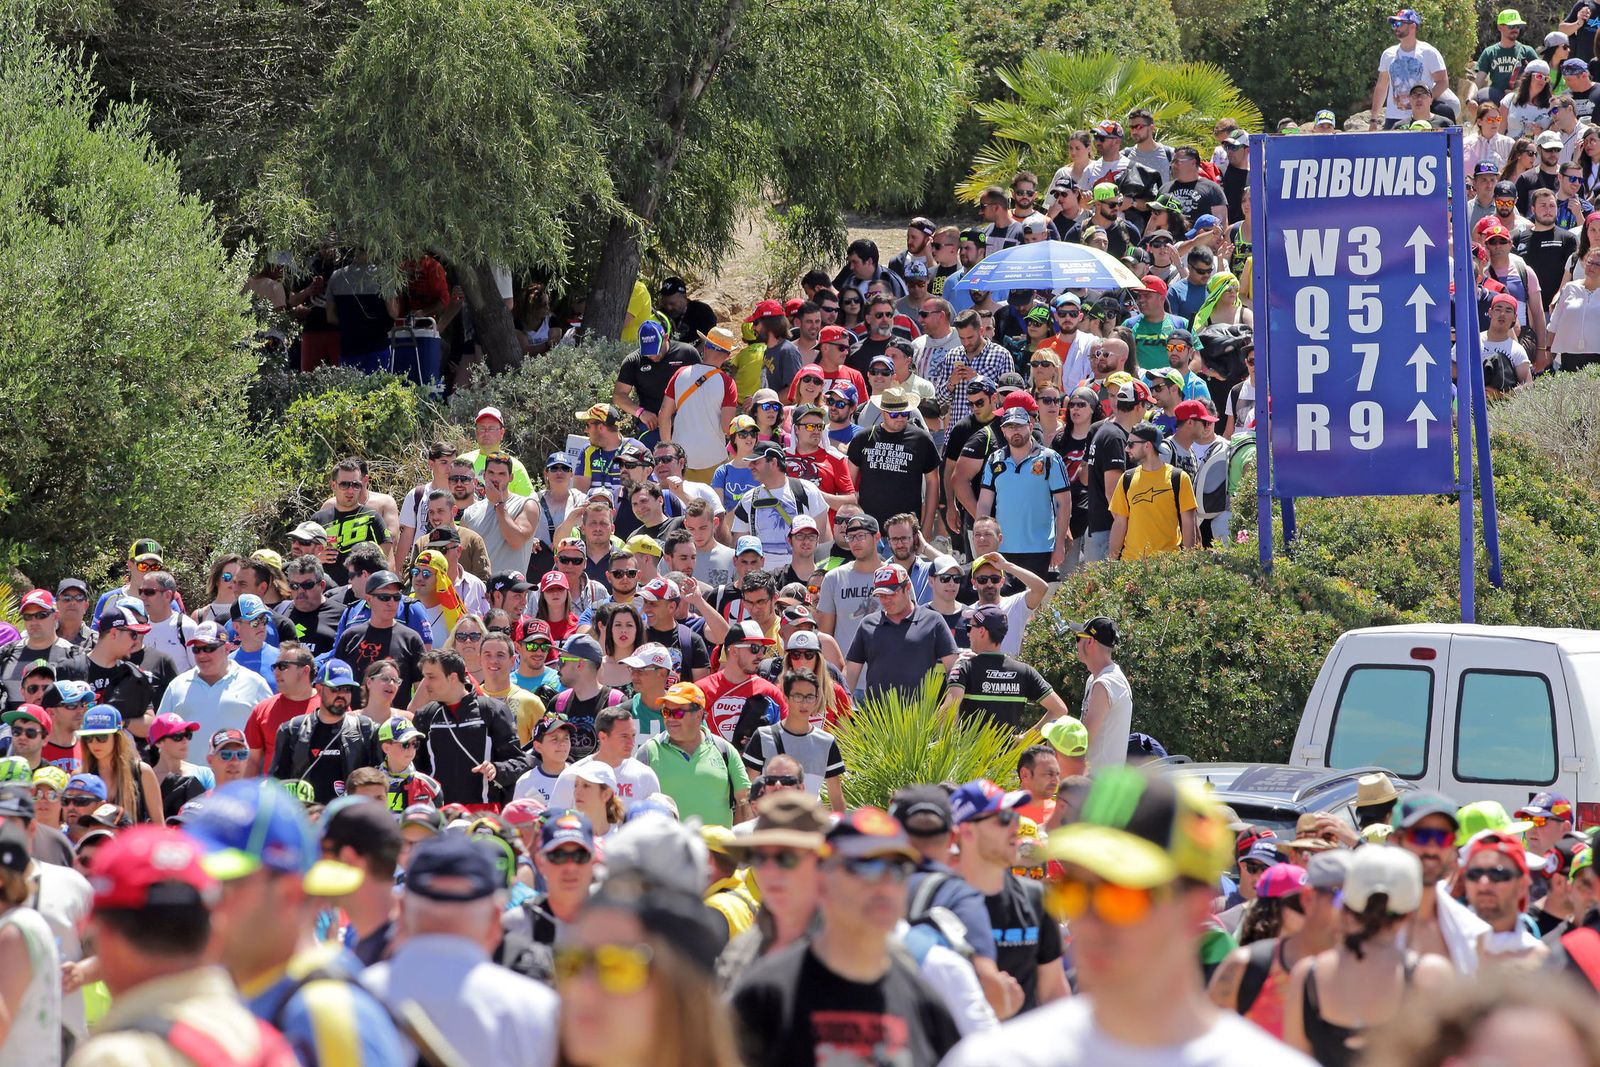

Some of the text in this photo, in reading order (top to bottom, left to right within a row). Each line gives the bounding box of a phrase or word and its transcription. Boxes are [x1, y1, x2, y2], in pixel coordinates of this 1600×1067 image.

[1280, 155, 1437, 199] TRIBUNAS
[1173, 188, 1202, 202] UTHSEA
[1283, 226, 1382, 277] W 3
[1294, 284, 1383, 341] Q 5
[1297, 343, 1380, 393] P 7
[1296, 400, 1384, 452] R 9
[874, 441, 905, 452] DESDE UN
[863, 447, 913, 461] PUEBLO REMOTO
[866, 454, 908, 467] DE LA SIERRA
[869, 461, 878, 469] DE
[546, 573, 562, 583] 93
[527, 620, 549, 635] 93
[991, 682, 1020, 692] YAMAHA
